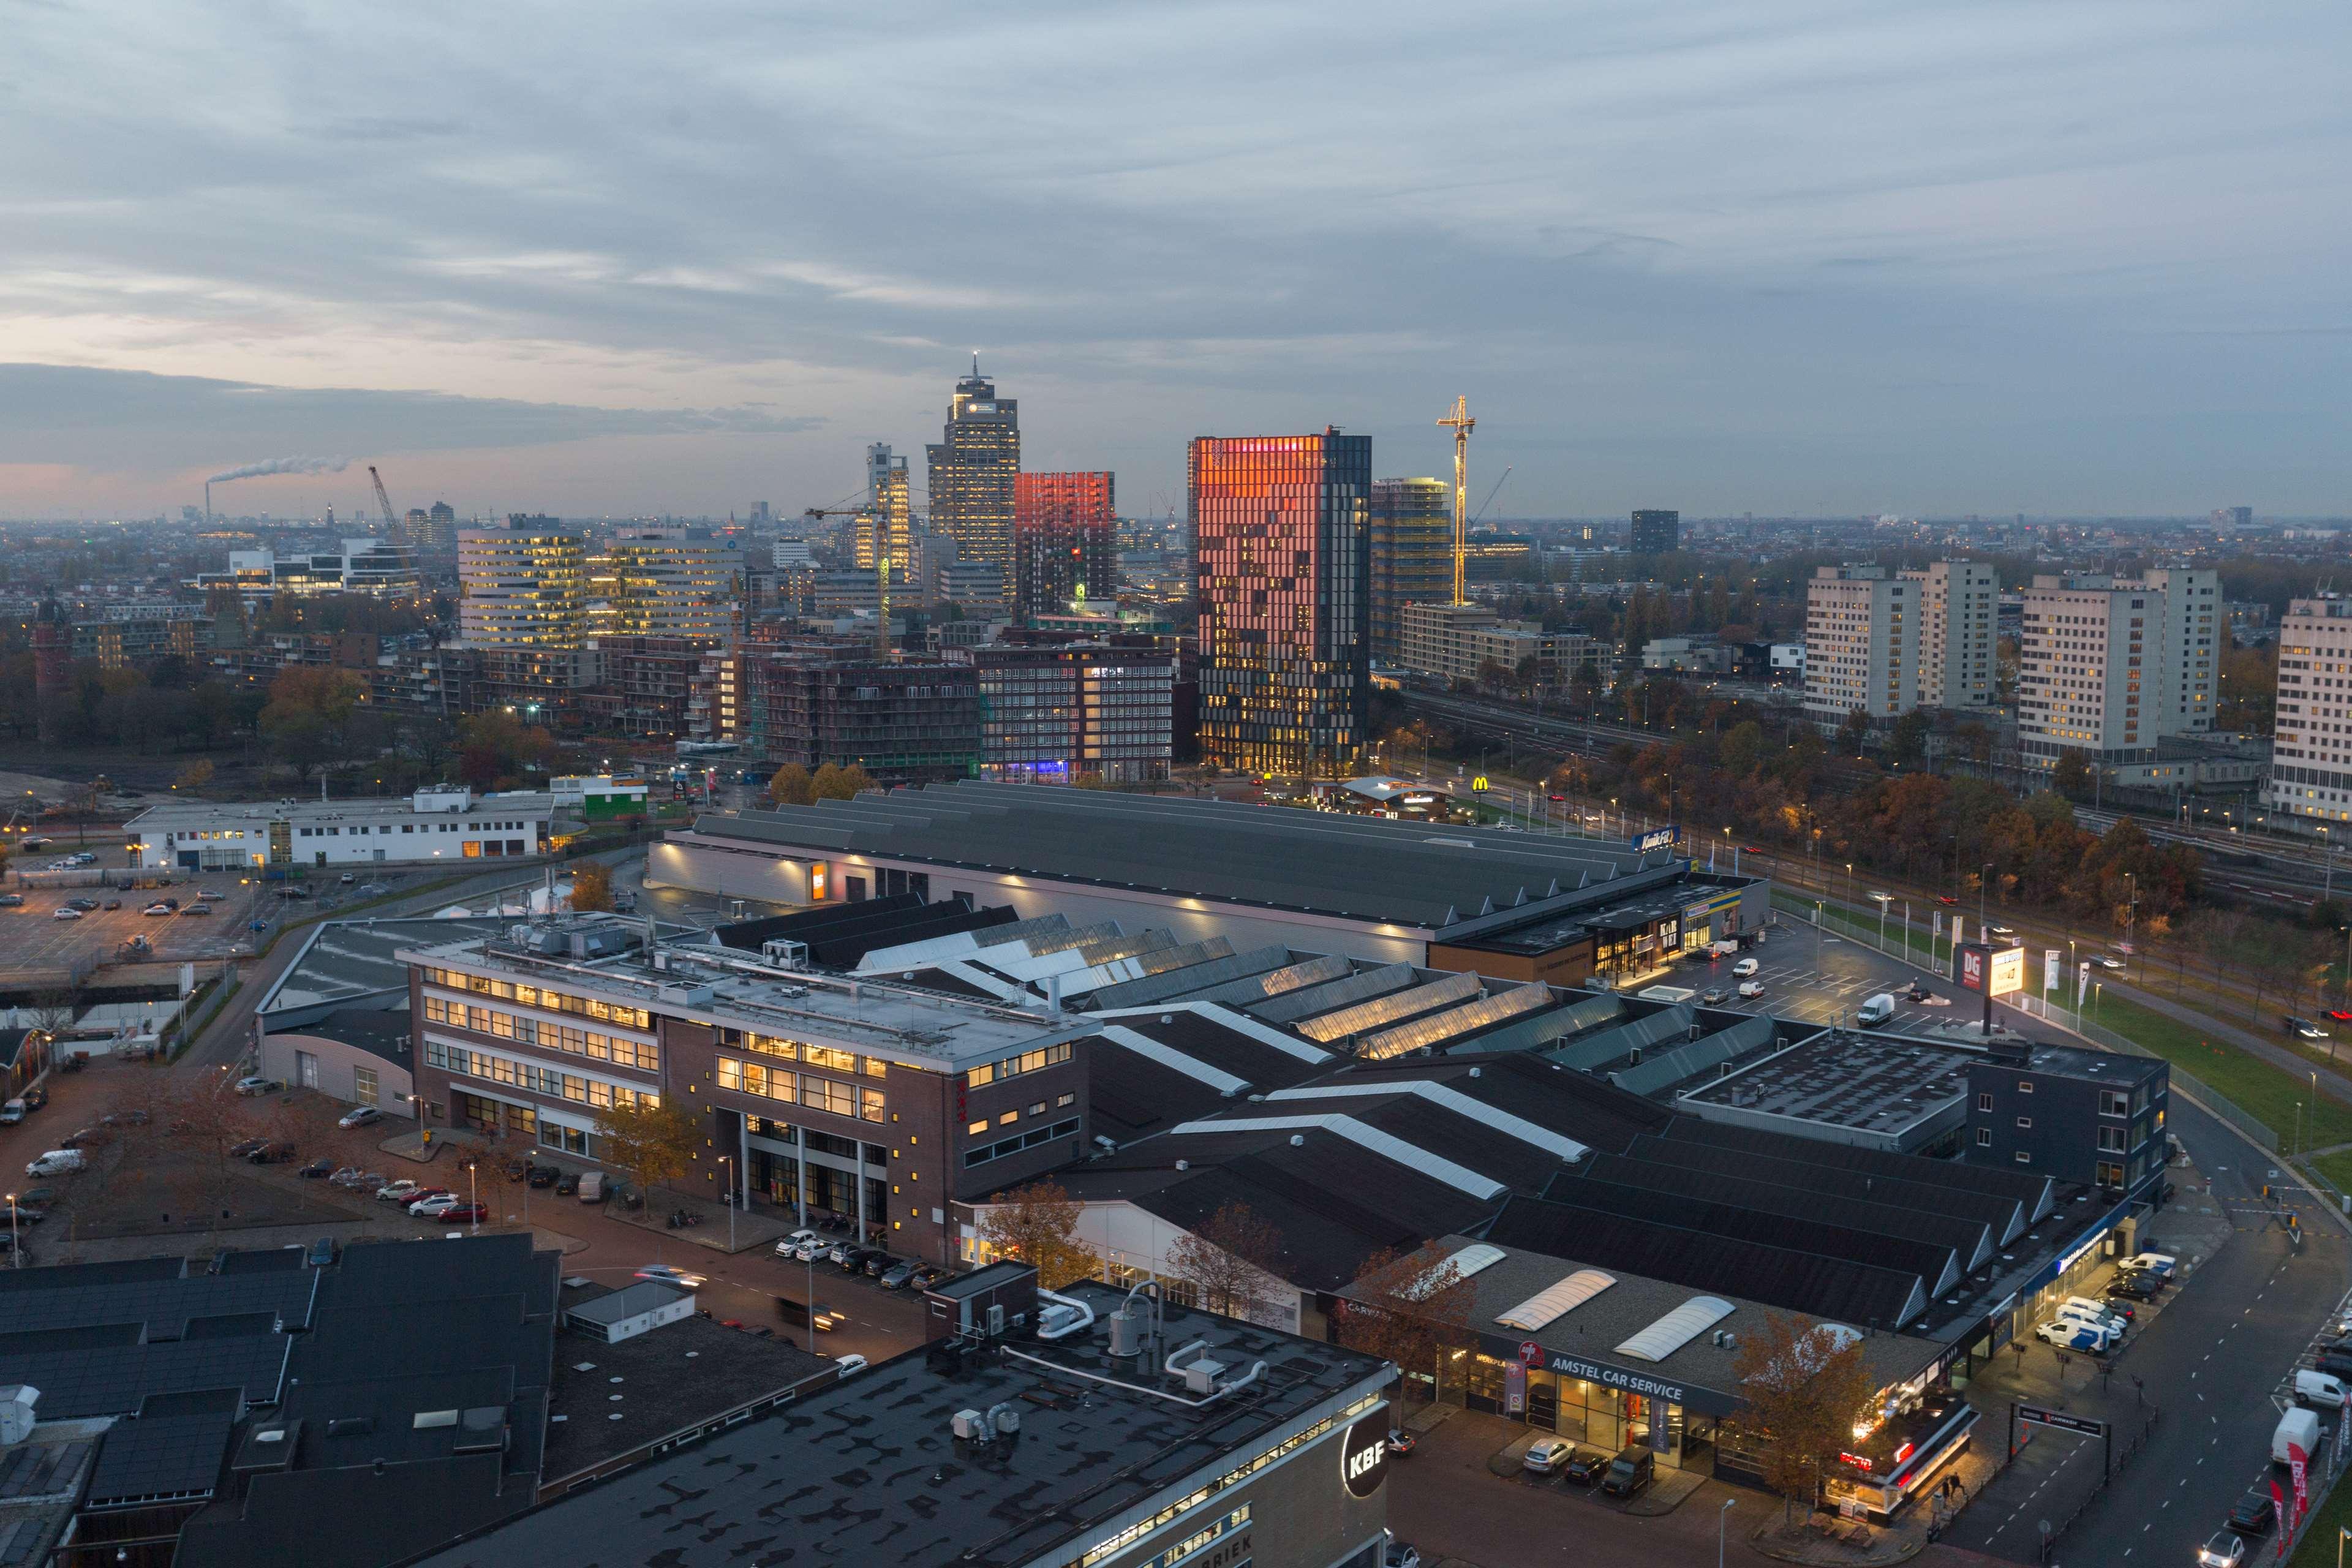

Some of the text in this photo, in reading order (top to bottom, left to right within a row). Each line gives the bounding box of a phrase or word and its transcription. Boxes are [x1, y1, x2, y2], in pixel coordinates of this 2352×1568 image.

[1964, 952, 1980, 976] DG
[1552, 1358, 1683, 1400] AMSTEL CAR SERVICE
[1350, 1439, 1385, 1479] KBF
